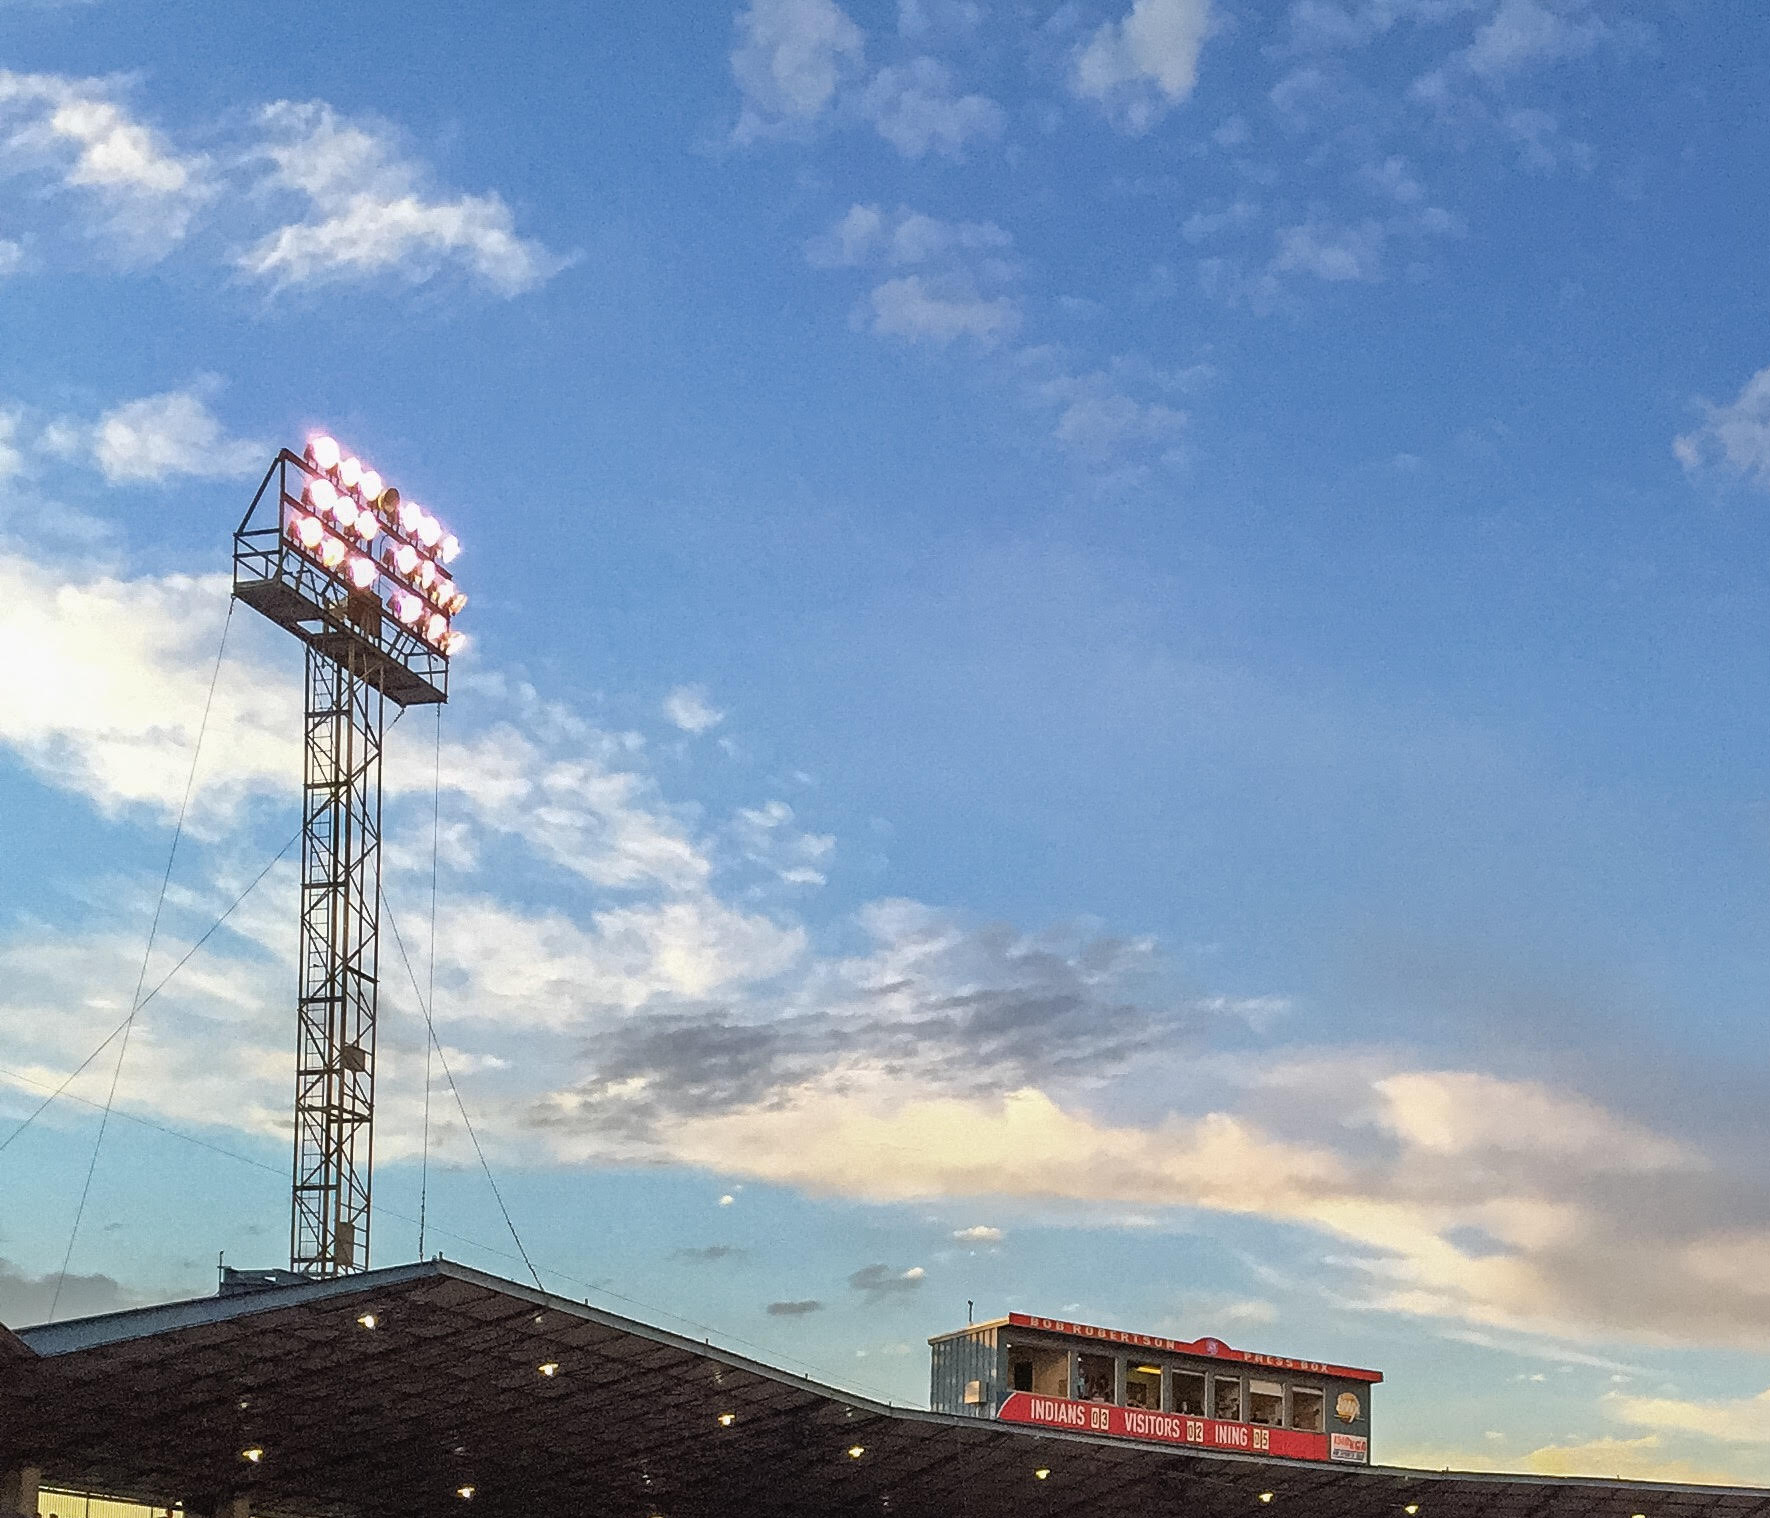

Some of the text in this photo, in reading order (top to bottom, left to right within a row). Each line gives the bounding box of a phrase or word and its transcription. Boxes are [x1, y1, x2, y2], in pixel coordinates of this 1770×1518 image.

[1030, 1316, 1175, 1350] BOB ROBERTSON
[1244, 1352, 1330, 1374] PRESS BOX
[1030, 1399, 1269, 1449] INDIANS 03 VISITORS 02 INING 05
